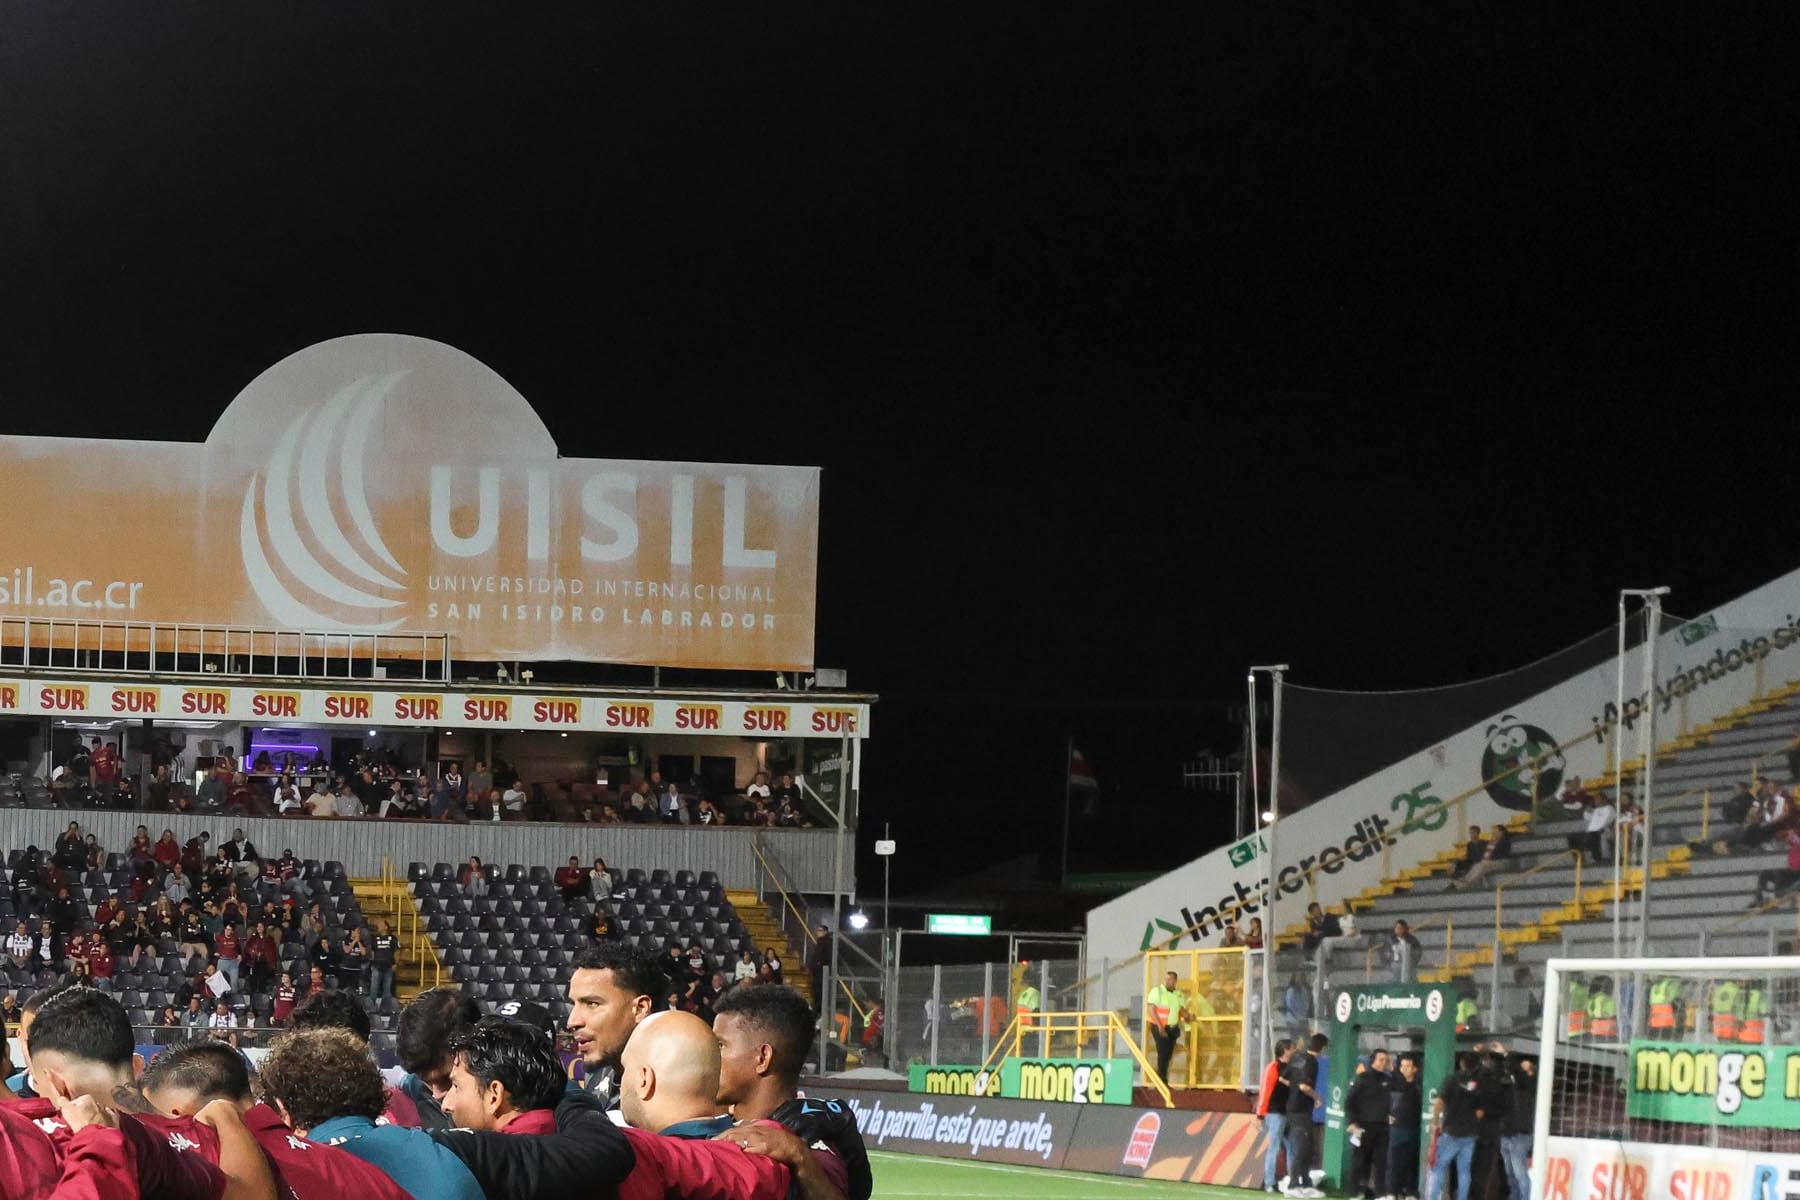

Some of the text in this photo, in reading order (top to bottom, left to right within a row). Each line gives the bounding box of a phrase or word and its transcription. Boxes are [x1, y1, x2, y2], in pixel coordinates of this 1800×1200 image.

[430, 464, 777, 569] UISIL
[428, 576, 776, 604] UNIVERSIDAD INTERNACIONAL
[427, 602, 776, 631] SAN ISIDRO LABRADOR
[1773, 614, 1800, 652] si
[39, 687, 85, 710] SUR
[110, 691, 156, 713] SUR
[182, 692, 226, 714] SUR
[251, 695, 297, 717] SUR
[325, 697, 370, 719] SUR
[395, 699, 438, 721] SUR
[465, 700, 508, 722] SUR
[534, 703, 576, 723] SUR
[606, 708, 651, 727] SUR
[676, 709, 718, 730] SUR
[744, 709, 790, 730] SUR
[1391, 782, 1448, 837] 25
[500, 1001, 522, 1016] S
[1019, 1061, 1105, 1104] monge
[1636, 1047, 1767, 1115] monge
[867, 1100, 884, 1136] la
[877, 1101, 937, 1146] parrilla
[935, 1105, 973, 1144] está
[971, 1117, 1004, 1157] que
[1002, 1110, 1054, 1160] arde,
